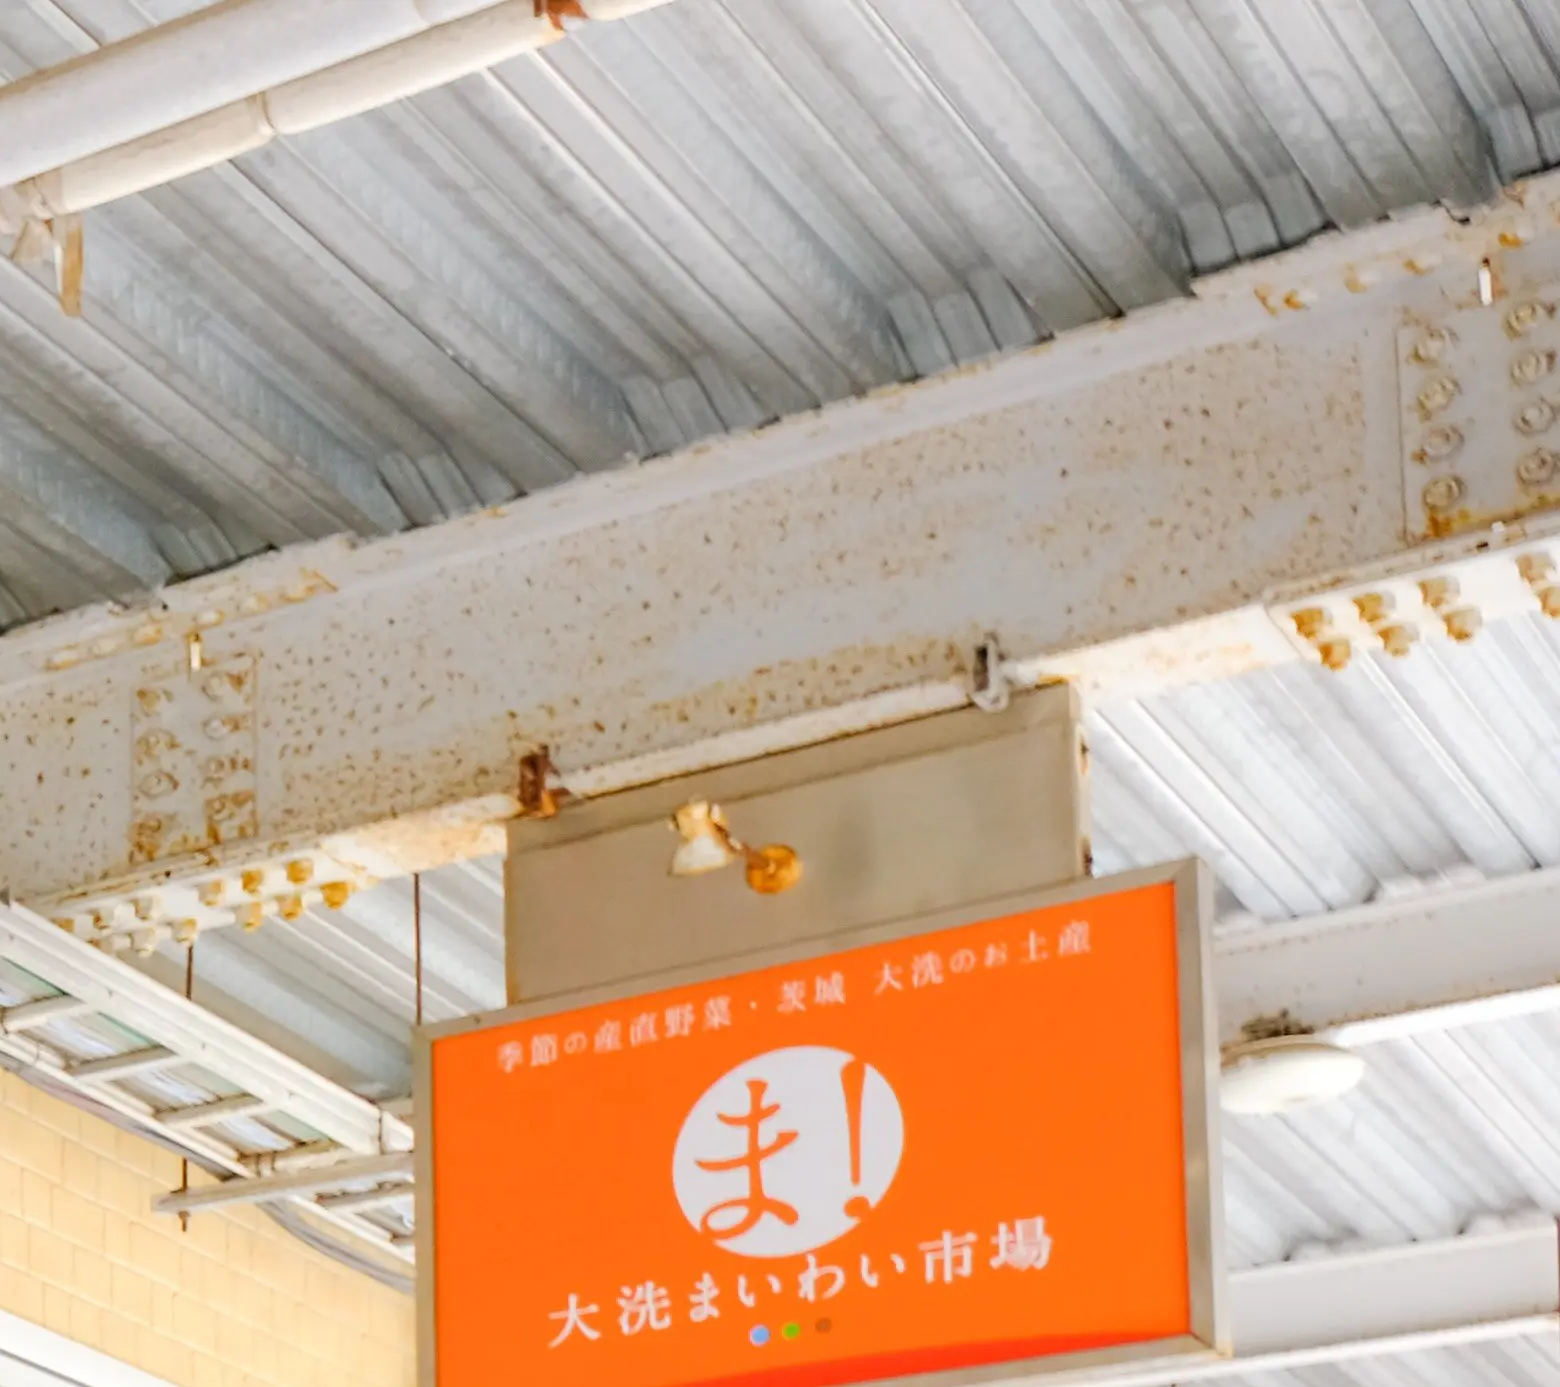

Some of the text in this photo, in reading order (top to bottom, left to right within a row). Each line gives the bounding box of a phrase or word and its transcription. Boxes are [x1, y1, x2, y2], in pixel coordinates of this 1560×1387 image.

[873, 919, 1093, 996] 大洗のお土産
[547, 1215, 1054, 1350] 大洗まいわい市場
